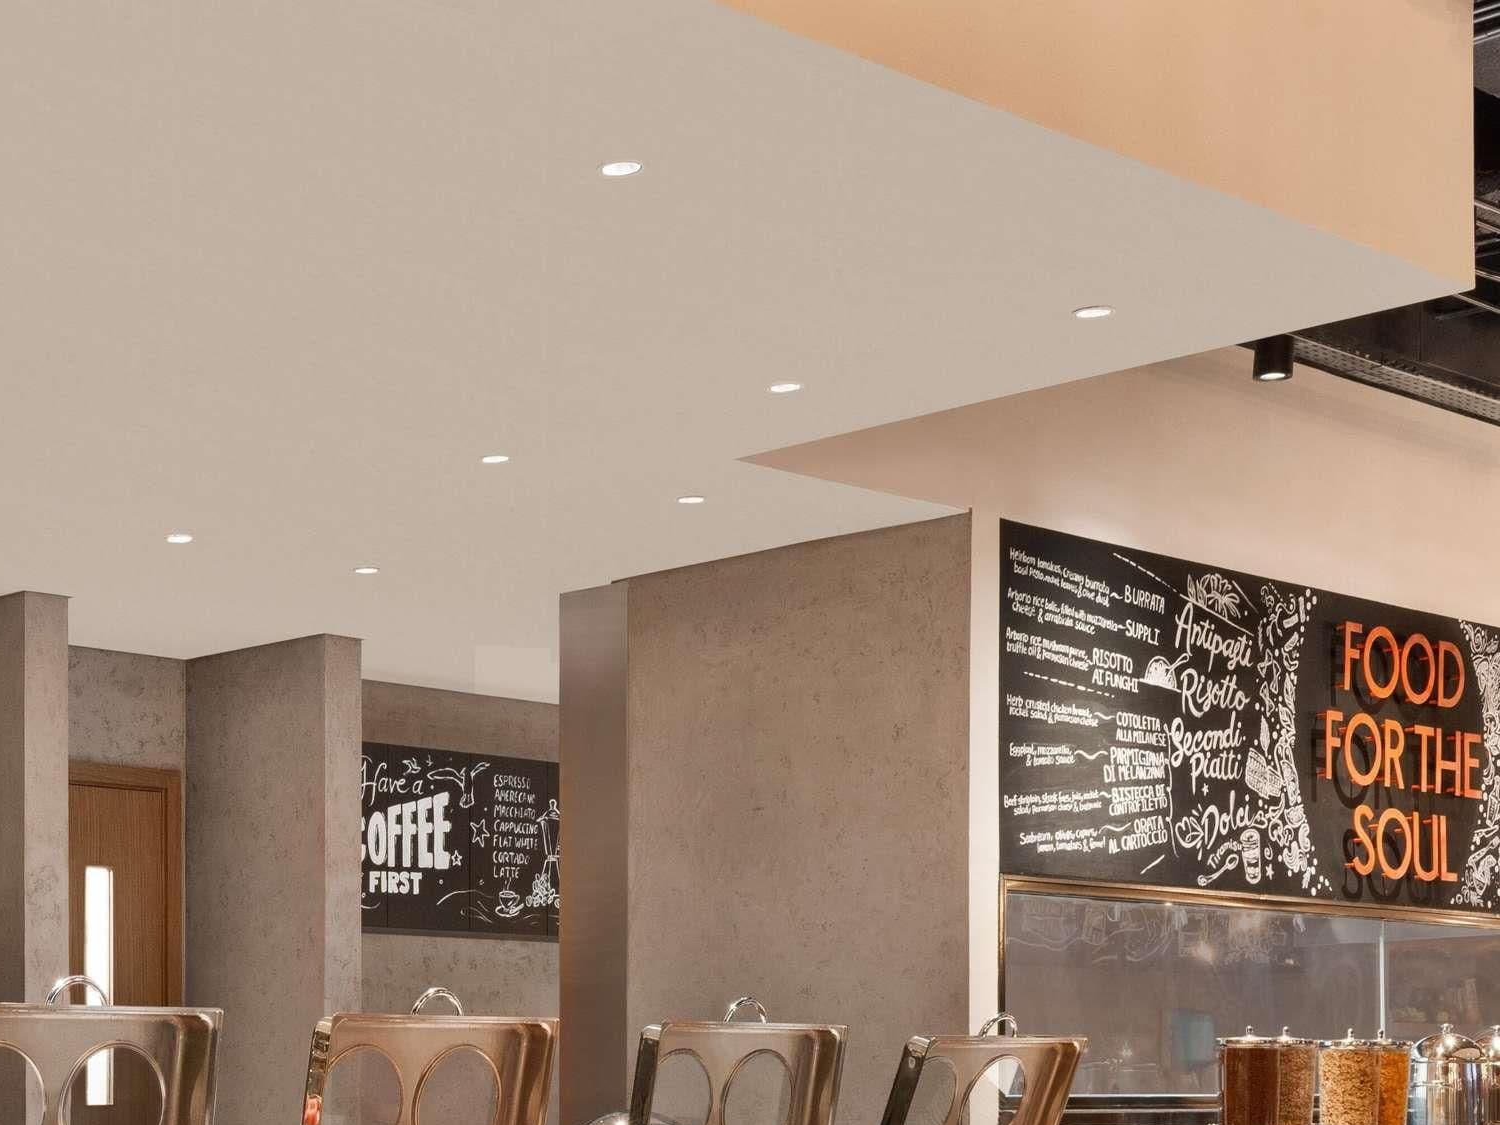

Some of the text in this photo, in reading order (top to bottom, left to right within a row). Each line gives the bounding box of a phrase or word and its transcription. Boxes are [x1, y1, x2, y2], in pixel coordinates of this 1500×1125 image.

[1124, 584, 1165, 615] BURRATA
[1125, 619, 1160, 646] SUPPLI
[1175, 602, 1253, 672] Antipasti
[1092, 648, 1133, 674] RISOTTO
[1343, 621, 1465, 708] FOOD
[1092, 669, 1139, 693] AI FUNGHI
[1006, 694, 1024, 707] Herb
[1180, 668, 1250, 718] Risotto
[1116, 711, 1161, 732] COTOLETTA
[1132, 730, 1167, 747] MILANESE
[1171, 710, 1242, 768] Secondi
[1110, 746, 1166, 766] PARMIGIANA
[1325, 709, 1484, 799] FOR THE
[361, 755, 424, 807] Have a
[493, 774, 531, 790] ESPRESSO
[1104, 764, 1166, 783] DI MELANZANA
[1112, 785, 1154, 803] BISTECCA
[1155, 784, 1165, 797] DI
[493, 804, 536, 820] MACCHIATO
[1109, 797, 1168, 816] CONTROFILETTO
[493, 819, 539, 835] CAPPUCCINO
[1133, 816, 1164, 834] ORATA
[1201, 790, 1253, 849] Dolci
[493, 834, 538, 850] FLAT WHITE
[1108, 829, 1168, 854] AL CARTOCCIO
[1352, 804, 1458, 882] SOUL
[492, 850, 531, 865] CORTADO
[369, 871, 423, 895] FIRST
[493, 865, 520, 879] LATTE
